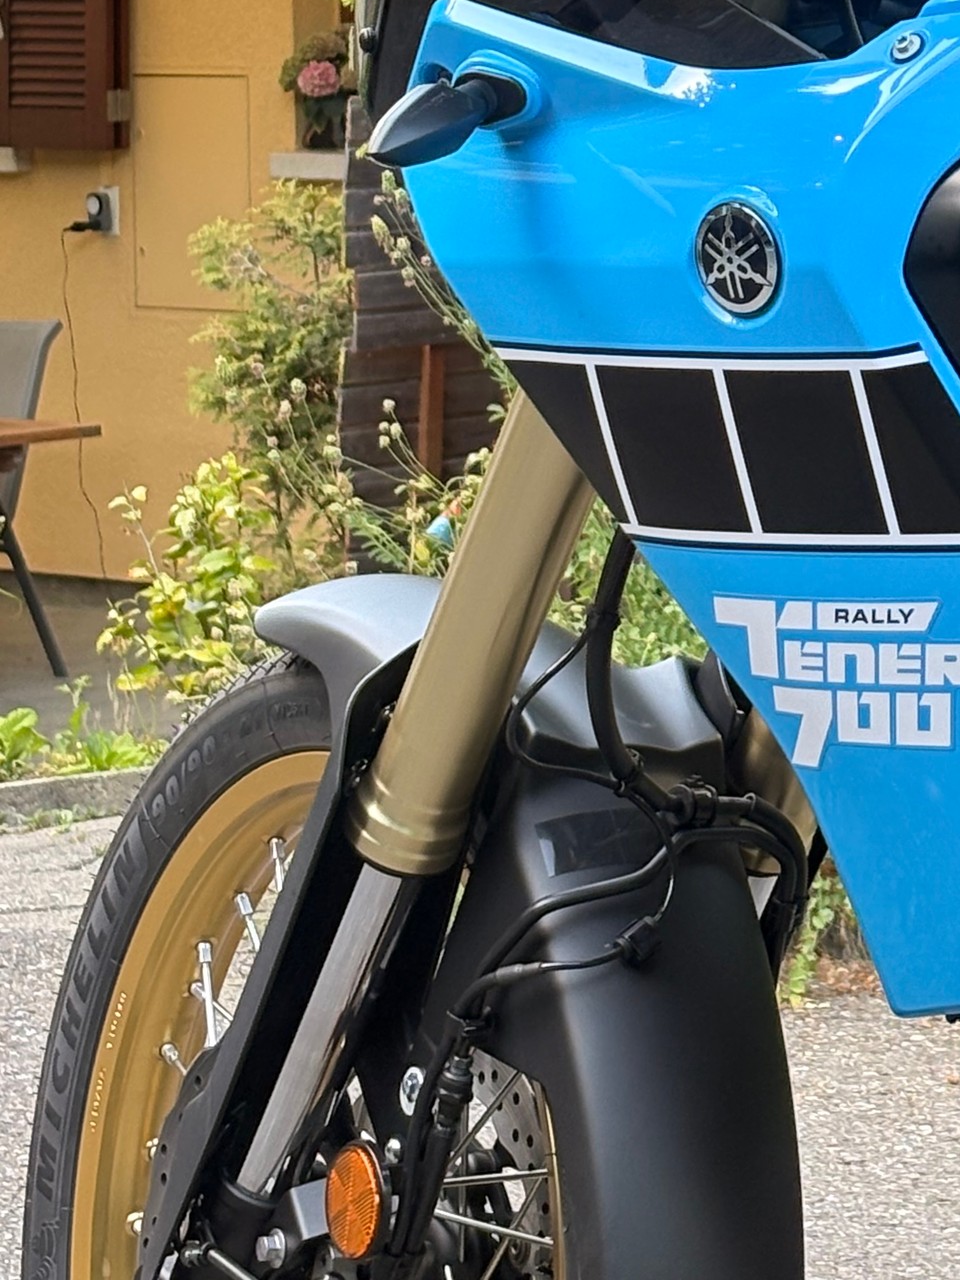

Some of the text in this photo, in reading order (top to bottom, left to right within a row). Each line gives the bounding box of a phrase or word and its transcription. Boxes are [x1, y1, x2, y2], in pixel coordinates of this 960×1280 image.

[834, 608, 915, 625] RALLY
[773, 686, 952, 768] 700
[35, 841, 142, 1200] MICHELIN
